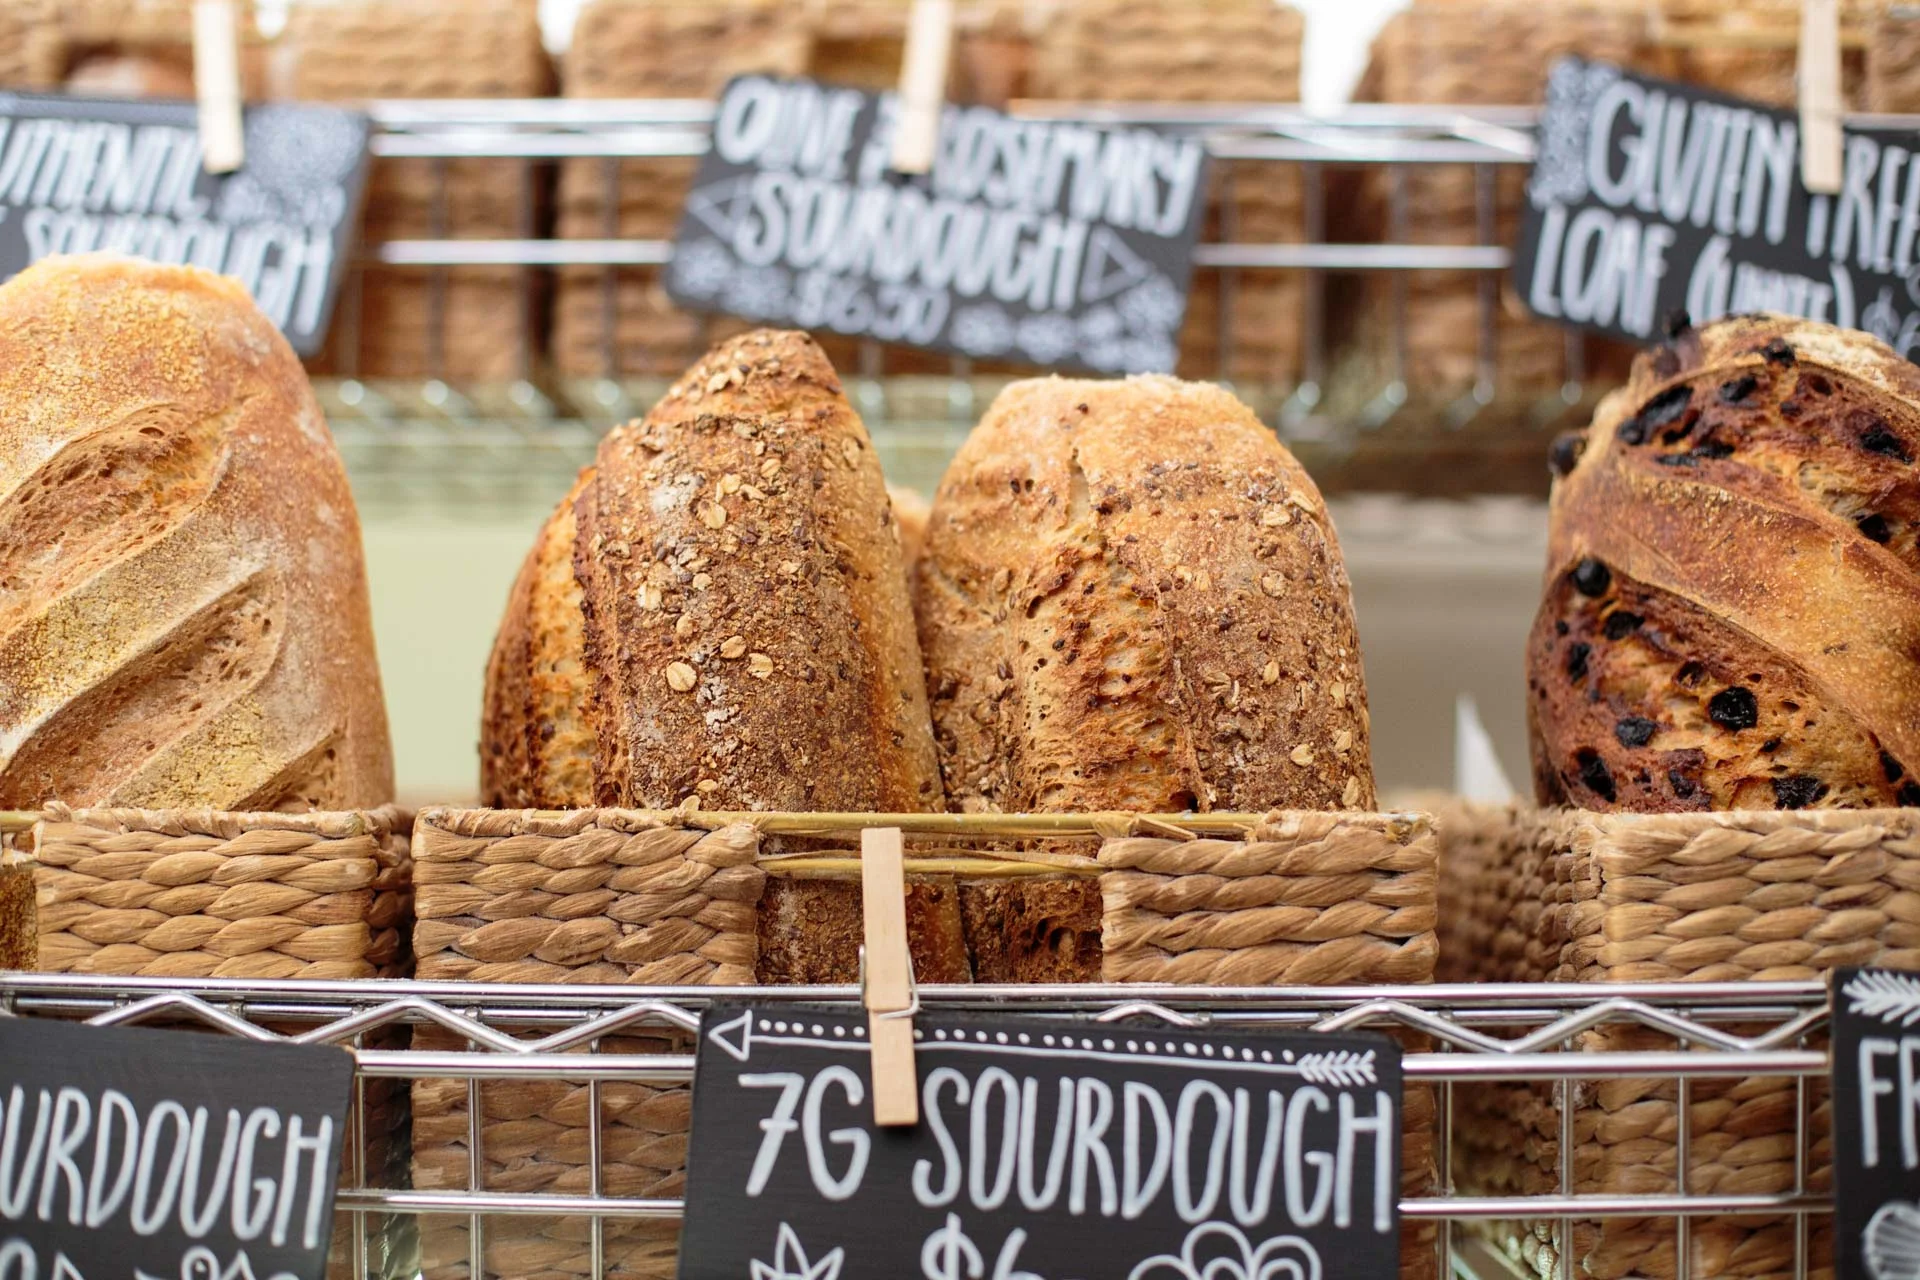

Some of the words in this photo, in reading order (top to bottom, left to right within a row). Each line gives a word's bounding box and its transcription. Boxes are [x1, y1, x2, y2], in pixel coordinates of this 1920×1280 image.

[732, 172, 1088, 311] SOURDOUGH
[1585, 80, 1797, 245] GLUTEN
[1531, 203, 1675, 339] LOAF
[0, 1084, 333, 1250] URDOUGH
[738, 1065, 871, 1200] 7G
[912, 1065, 1393, 1232] SOURDOUGH
